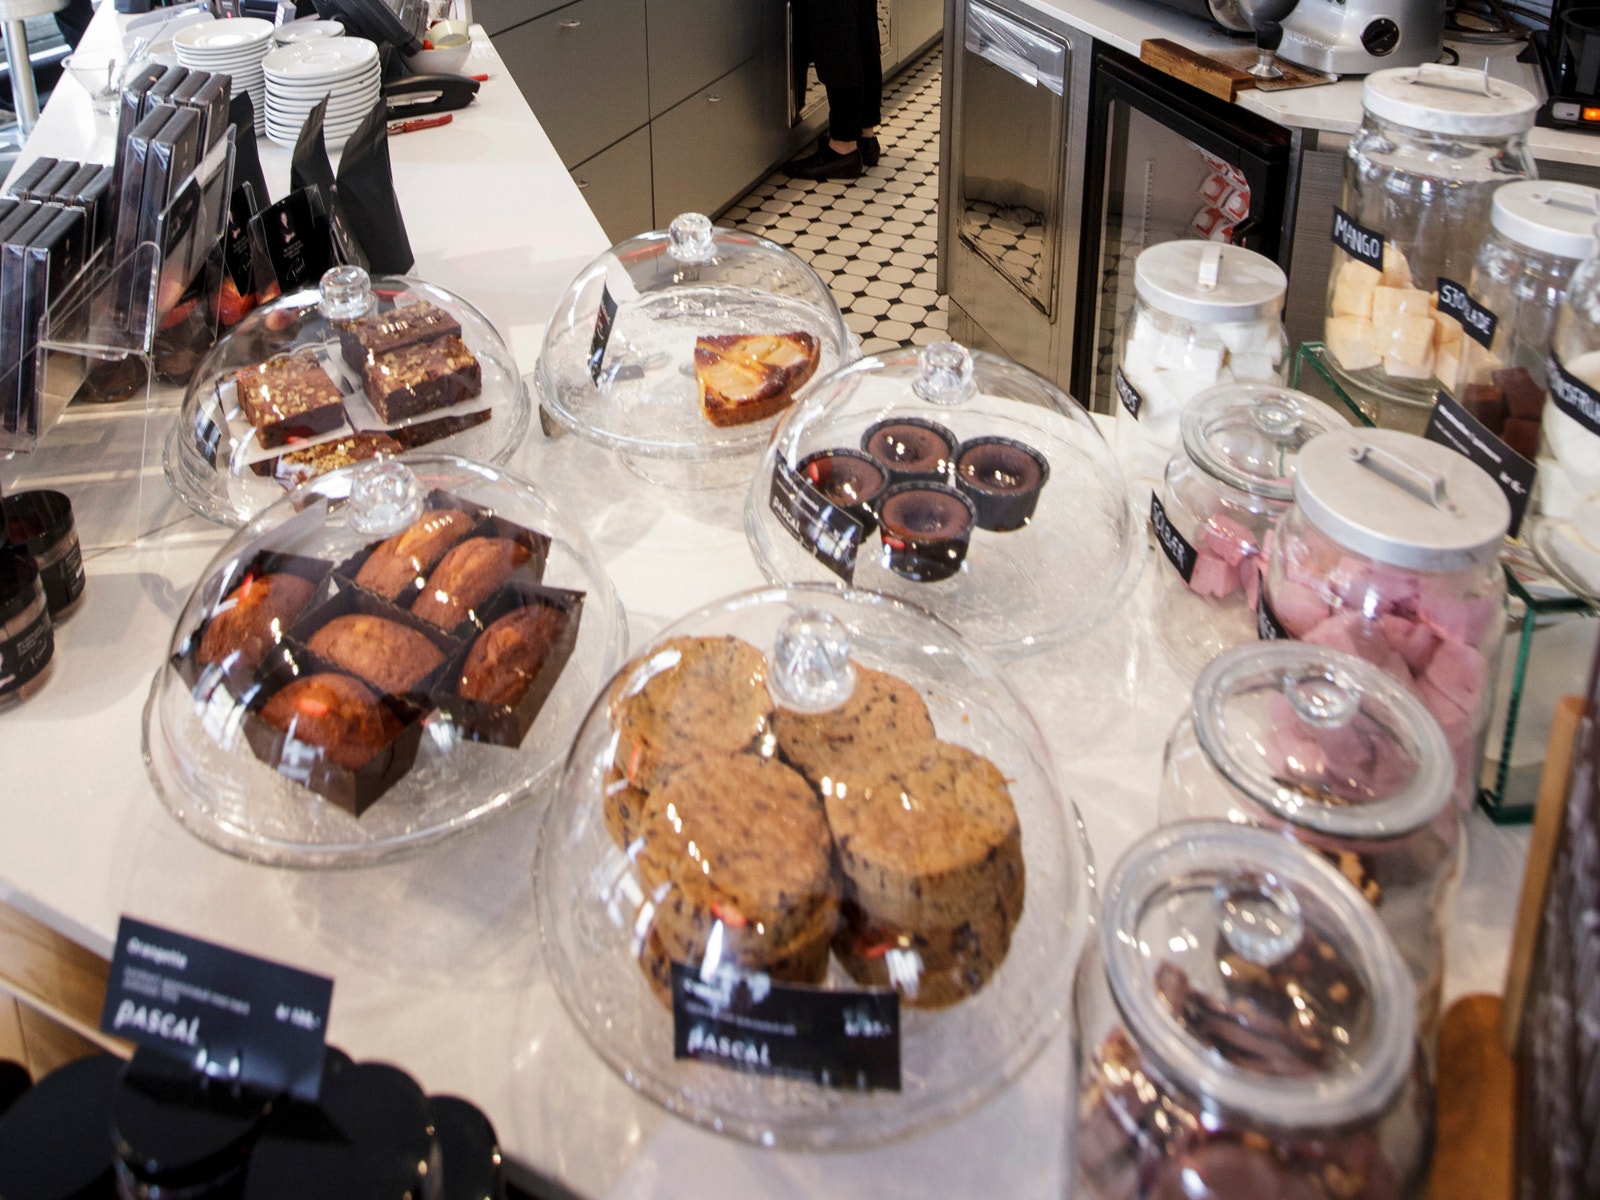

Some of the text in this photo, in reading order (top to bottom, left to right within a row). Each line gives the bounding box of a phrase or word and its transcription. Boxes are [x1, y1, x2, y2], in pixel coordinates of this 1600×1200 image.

[1334, 214, 1380, 258] MANGO
[772, 496, 800, 534] PASCAL
[113, 998, 200, 1046] PASCAL
